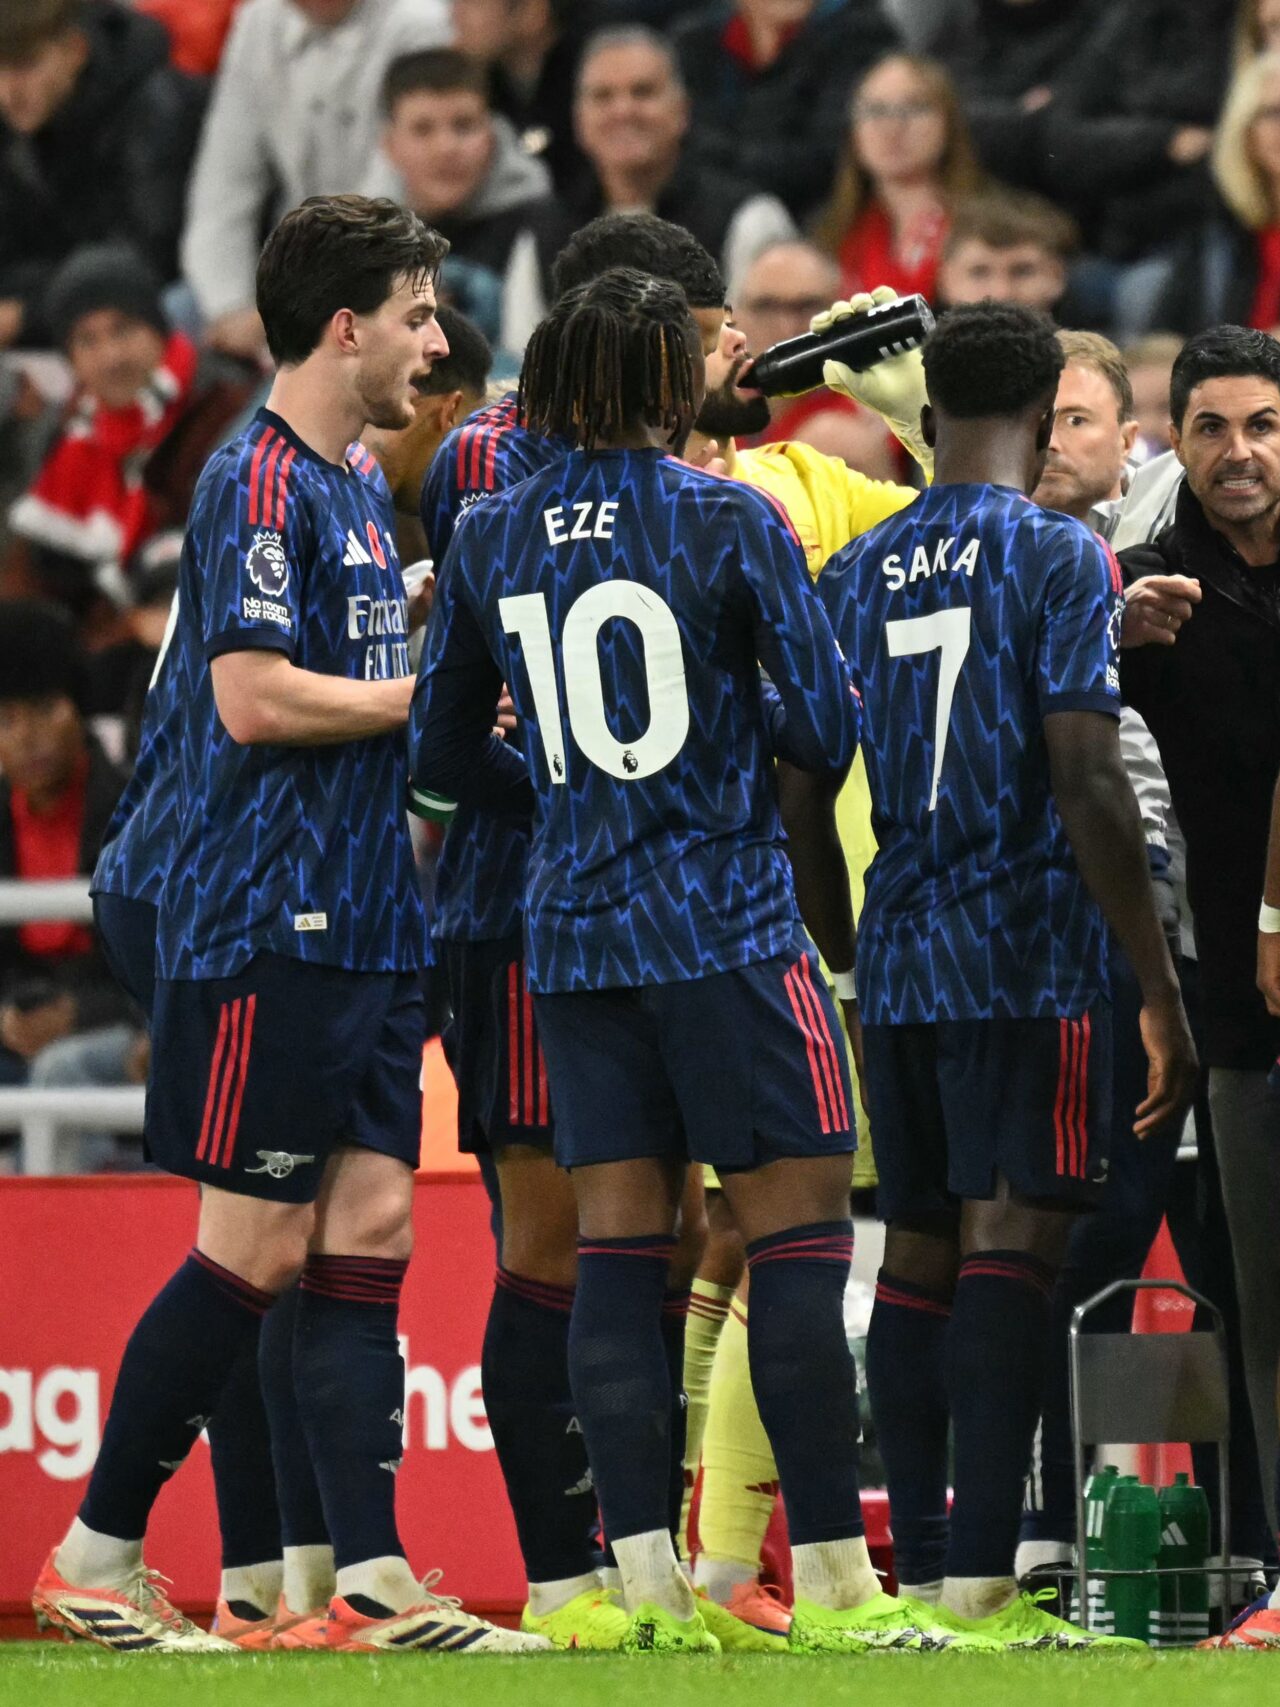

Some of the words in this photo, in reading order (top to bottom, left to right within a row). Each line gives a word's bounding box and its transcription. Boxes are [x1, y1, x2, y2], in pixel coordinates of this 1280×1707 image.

[544, 501, 619, 546] EZE
[882, 538, 980, 591] SAKA
[243, 597, 261, 608] No
[263, 600, 288, 616] room
[244, 607, 261, 618] For
[498, 579, 689, 784] 10
[886, 607, 971, 811] 7
